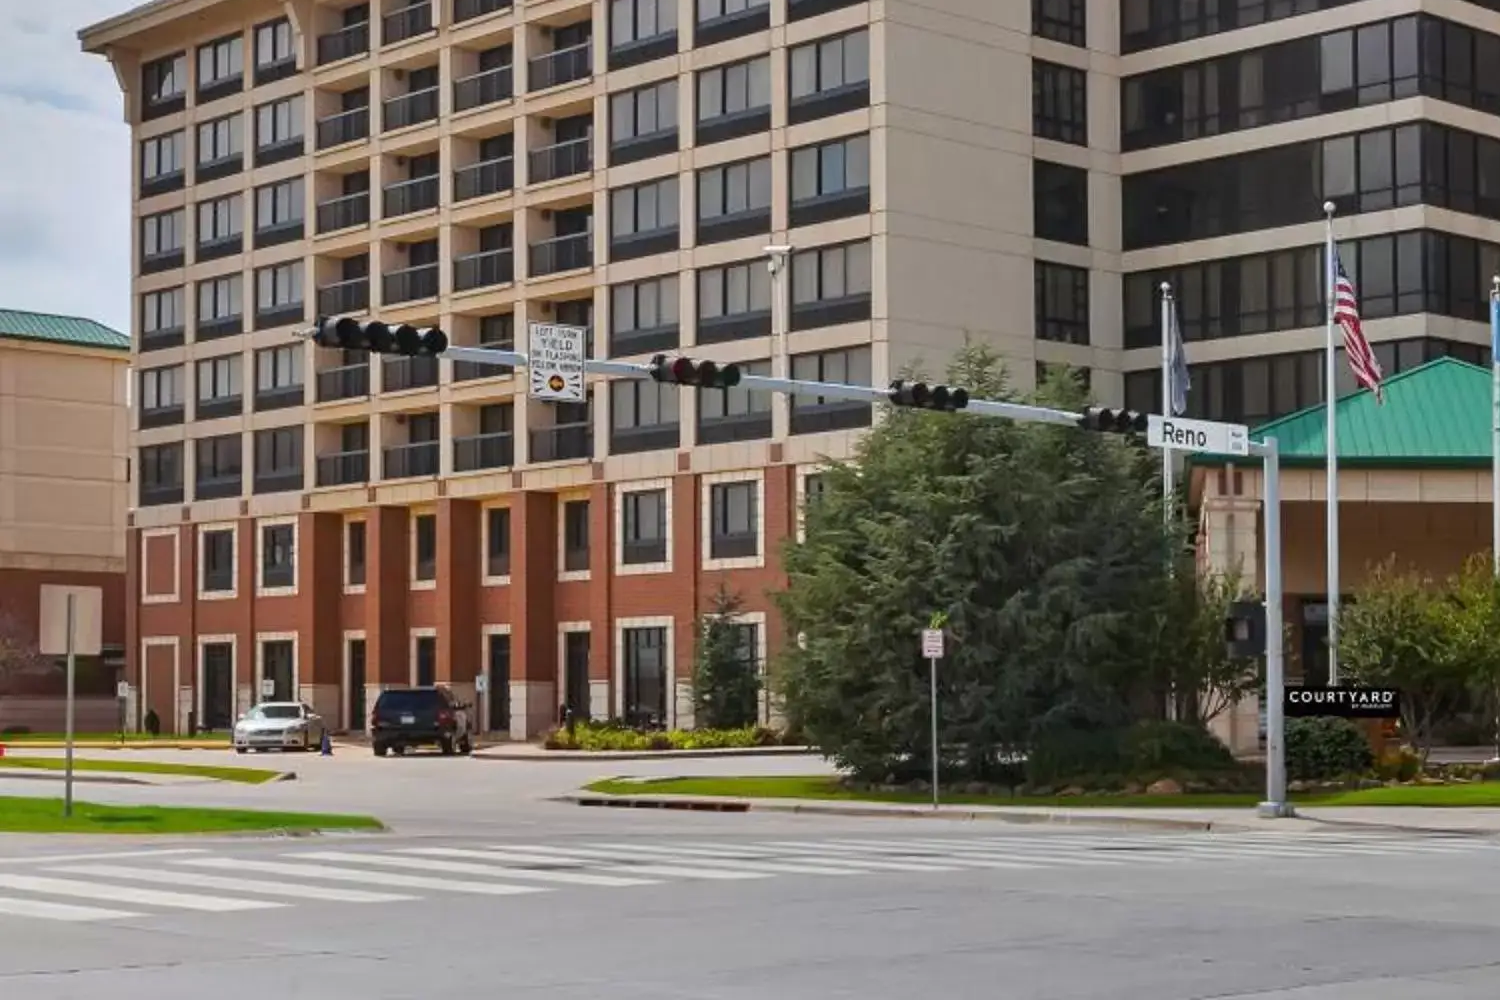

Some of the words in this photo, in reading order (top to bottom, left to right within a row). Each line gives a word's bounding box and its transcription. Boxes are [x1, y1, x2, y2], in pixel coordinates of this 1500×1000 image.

[540, 338, 574, 351] YIELD
[1162, 421, 1207, 447] Reno
[1289, 691, 1393, 704] COURTYARD
